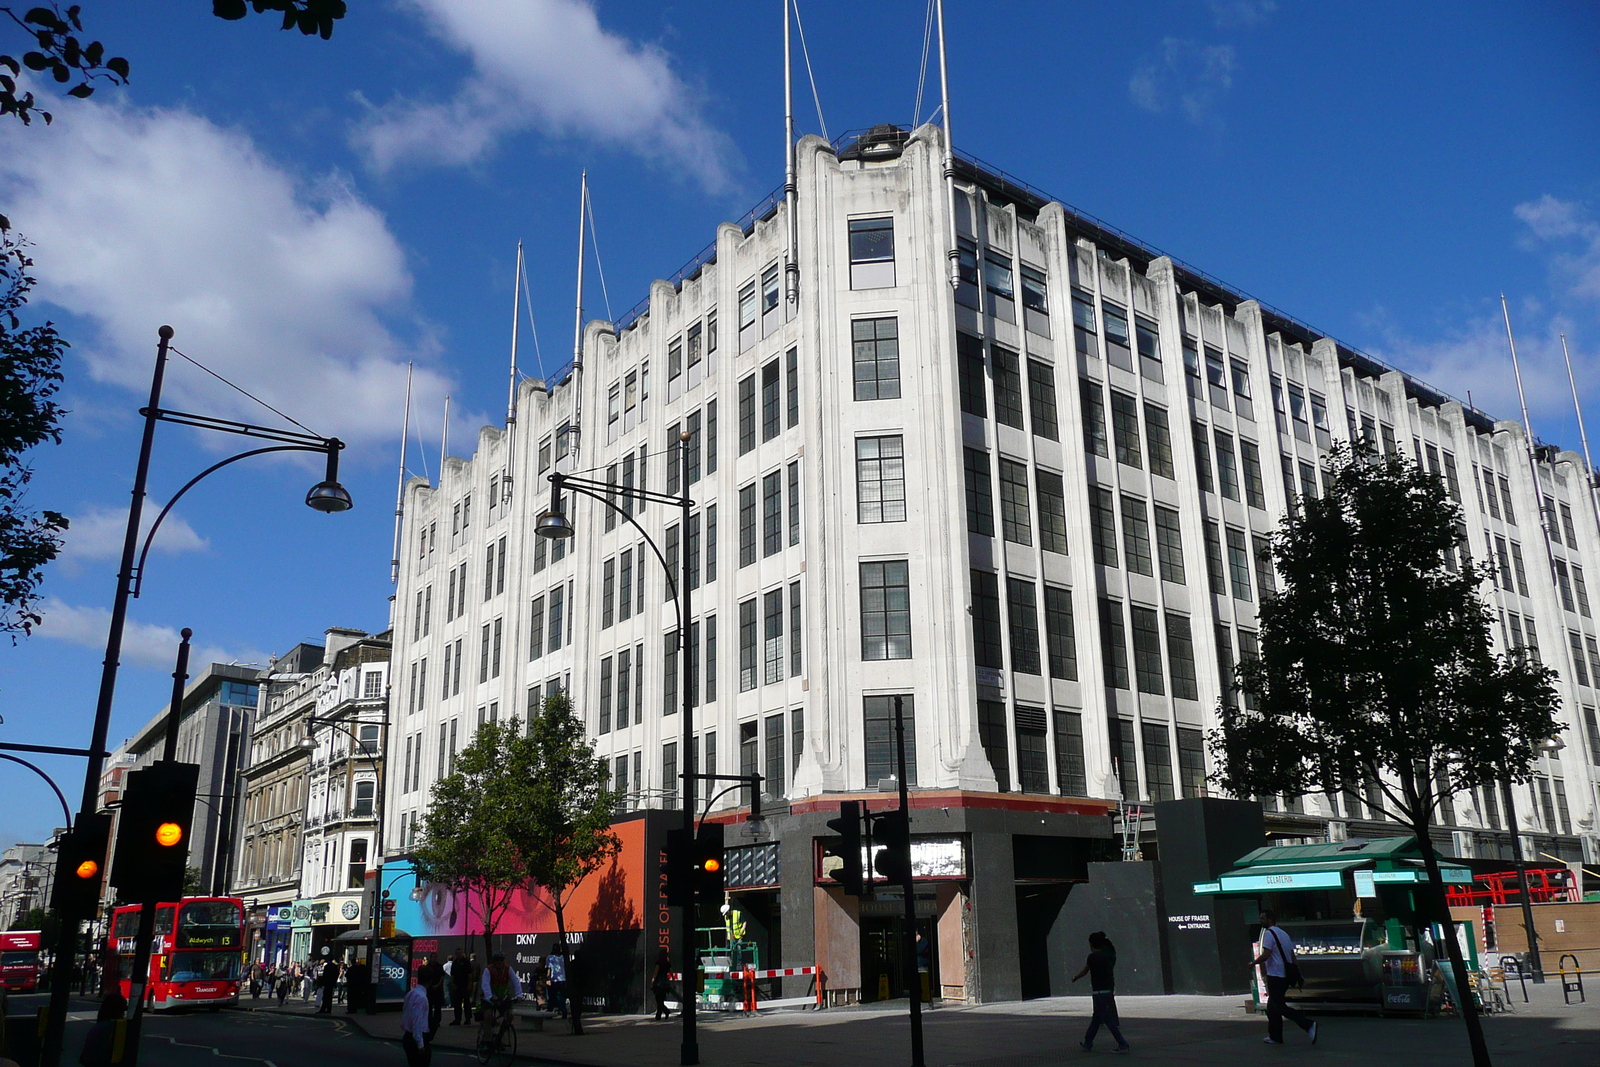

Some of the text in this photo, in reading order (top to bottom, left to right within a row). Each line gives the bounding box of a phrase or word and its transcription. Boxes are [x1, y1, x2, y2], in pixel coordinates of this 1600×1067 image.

[1266, 876, 1293, 884] GELATERIA
[659, 904, 670, 923] OF
[221, 936, 231, 945] 13
[516, 934, 537, 945] DKNY
